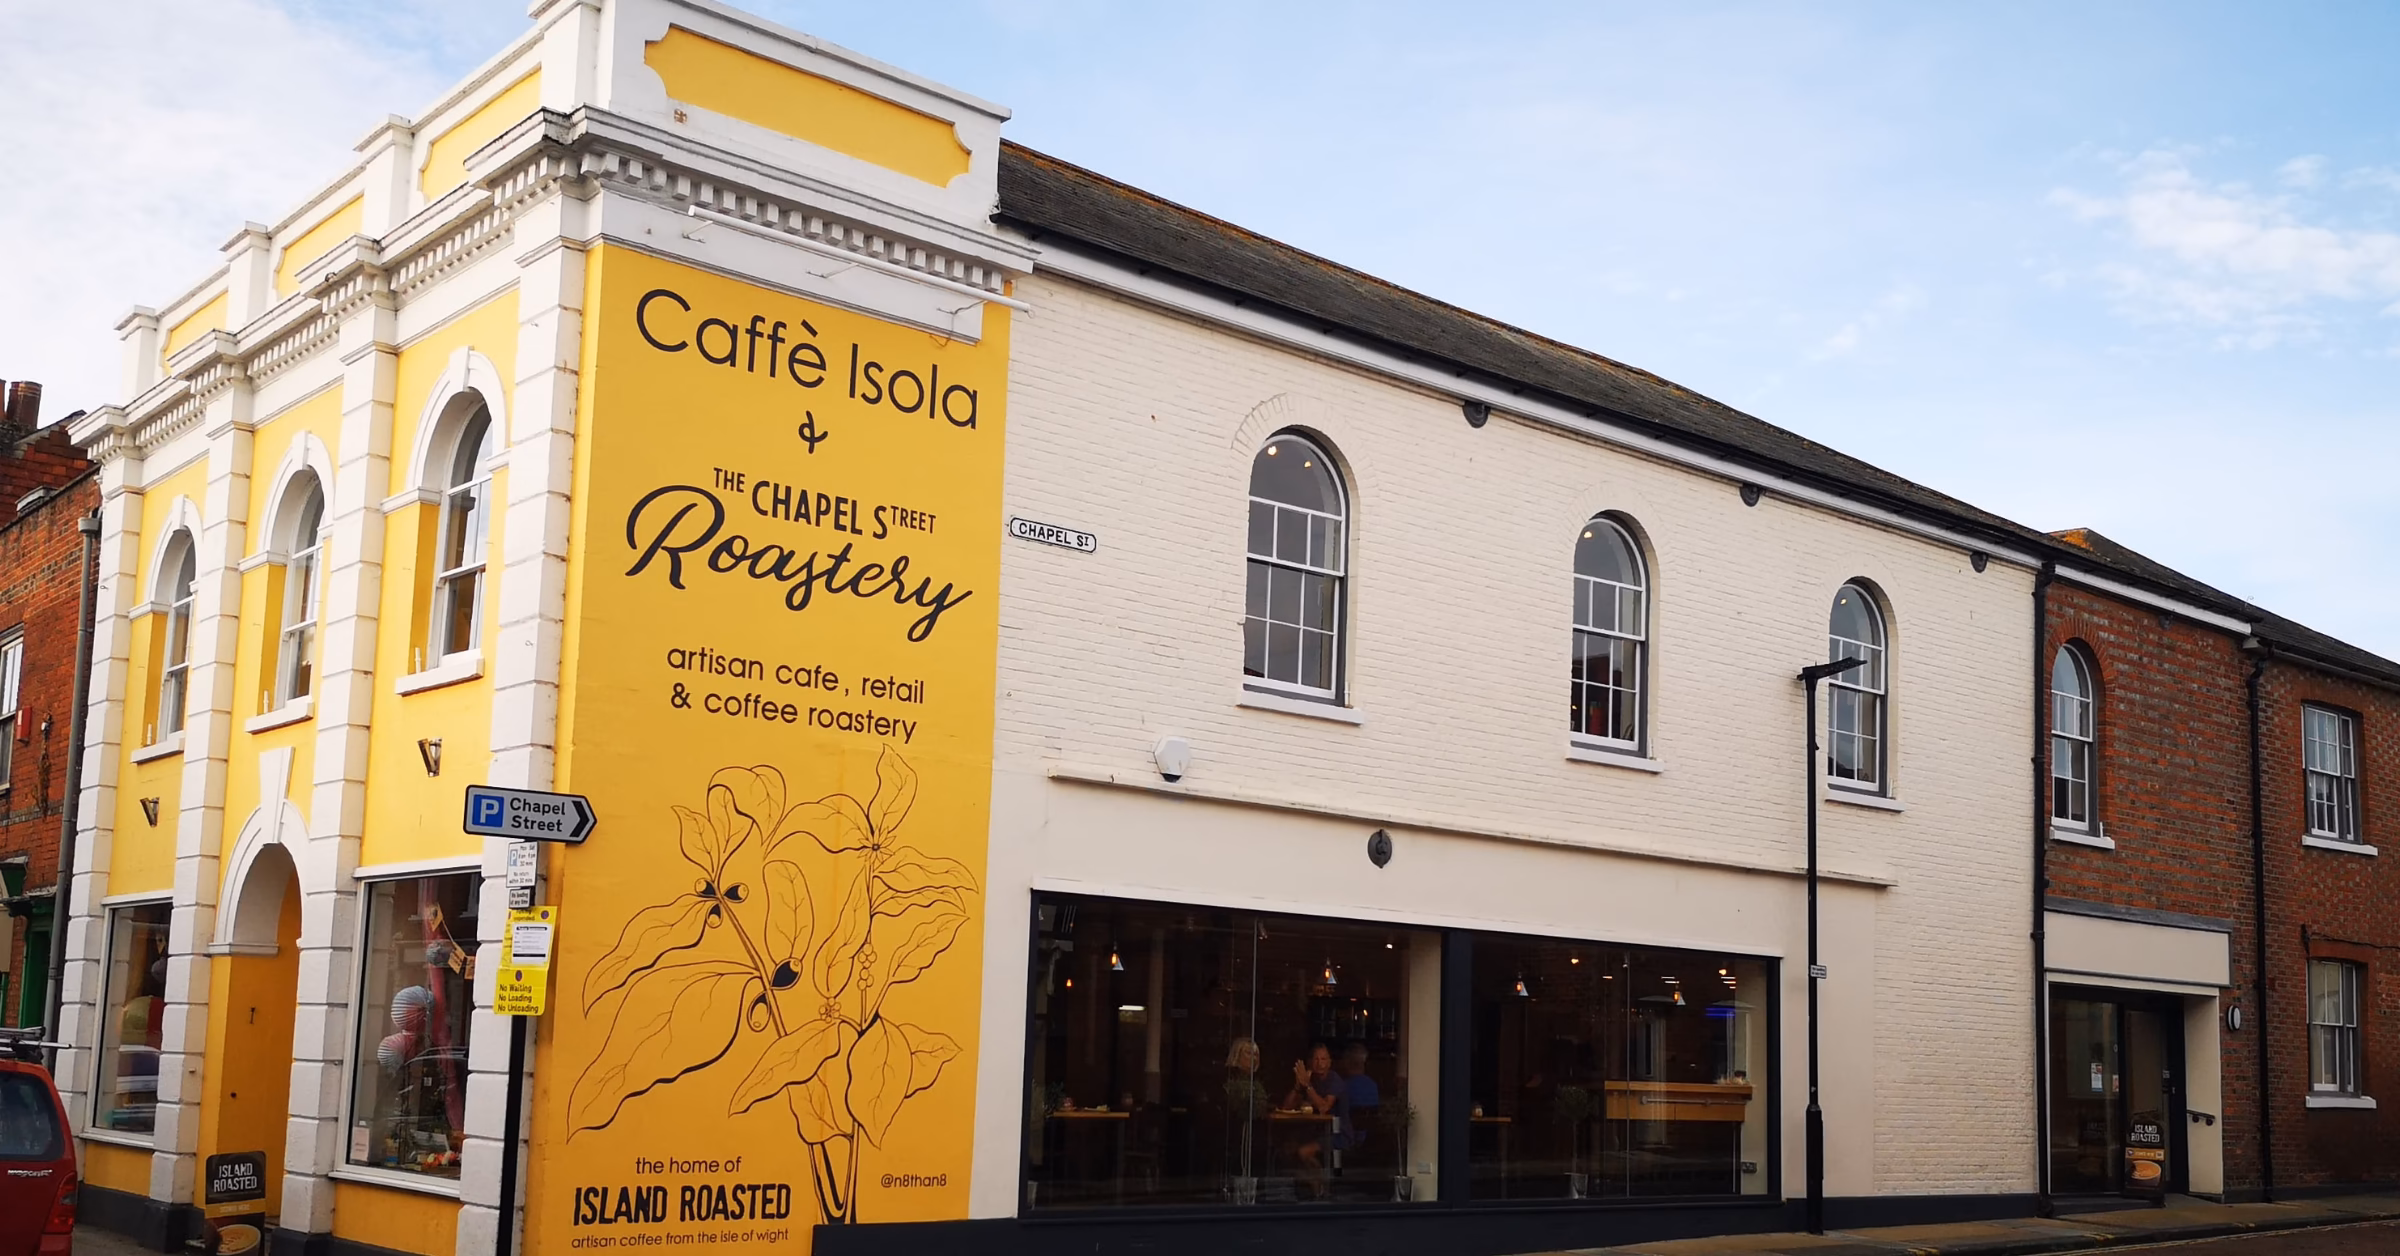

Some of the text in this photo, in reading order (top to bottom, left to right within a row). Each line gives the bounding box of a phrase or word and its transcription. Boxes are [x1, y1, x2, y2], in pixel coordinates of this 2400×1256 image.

[636, 288, 978, 430] Caffè Isola
[713, 467, 937, 541] THE CHAPEL STREET
[1018, 522, 1072, 545] CHAPEL
[625, 485, 973, 643] Roastery
[666, 646, 764, 681] artisan
[861, 675, 924, 705] retail
[670, 682, 917, 745] & coffee roastery
[480, 799, 500, 824] P
[509, 797, 566, 816] Chapel
[511, 815, 563, 832] Street
[500, 984, 532, 994] No Waiting
[508, 994, 532, 1003] Loading
[498, 1004, 539, 1014] No Unloading
[2131, 1132, 2160, 1142] ROASTED
[2134, 1124, 2157, 1133] ISLAND
[219, 1163, 253, 1178] ISLAND
[635, 1156, 742, 1174] the home of
[214, 1176, 257, 1192] ROASTED
[880, 1173, 947, 1188] @n8than8
[573, 1183, 791, 1227] ISLAND ROASTED
[571, 1228, 789, 1249] artisan coffee from the isle of wight
